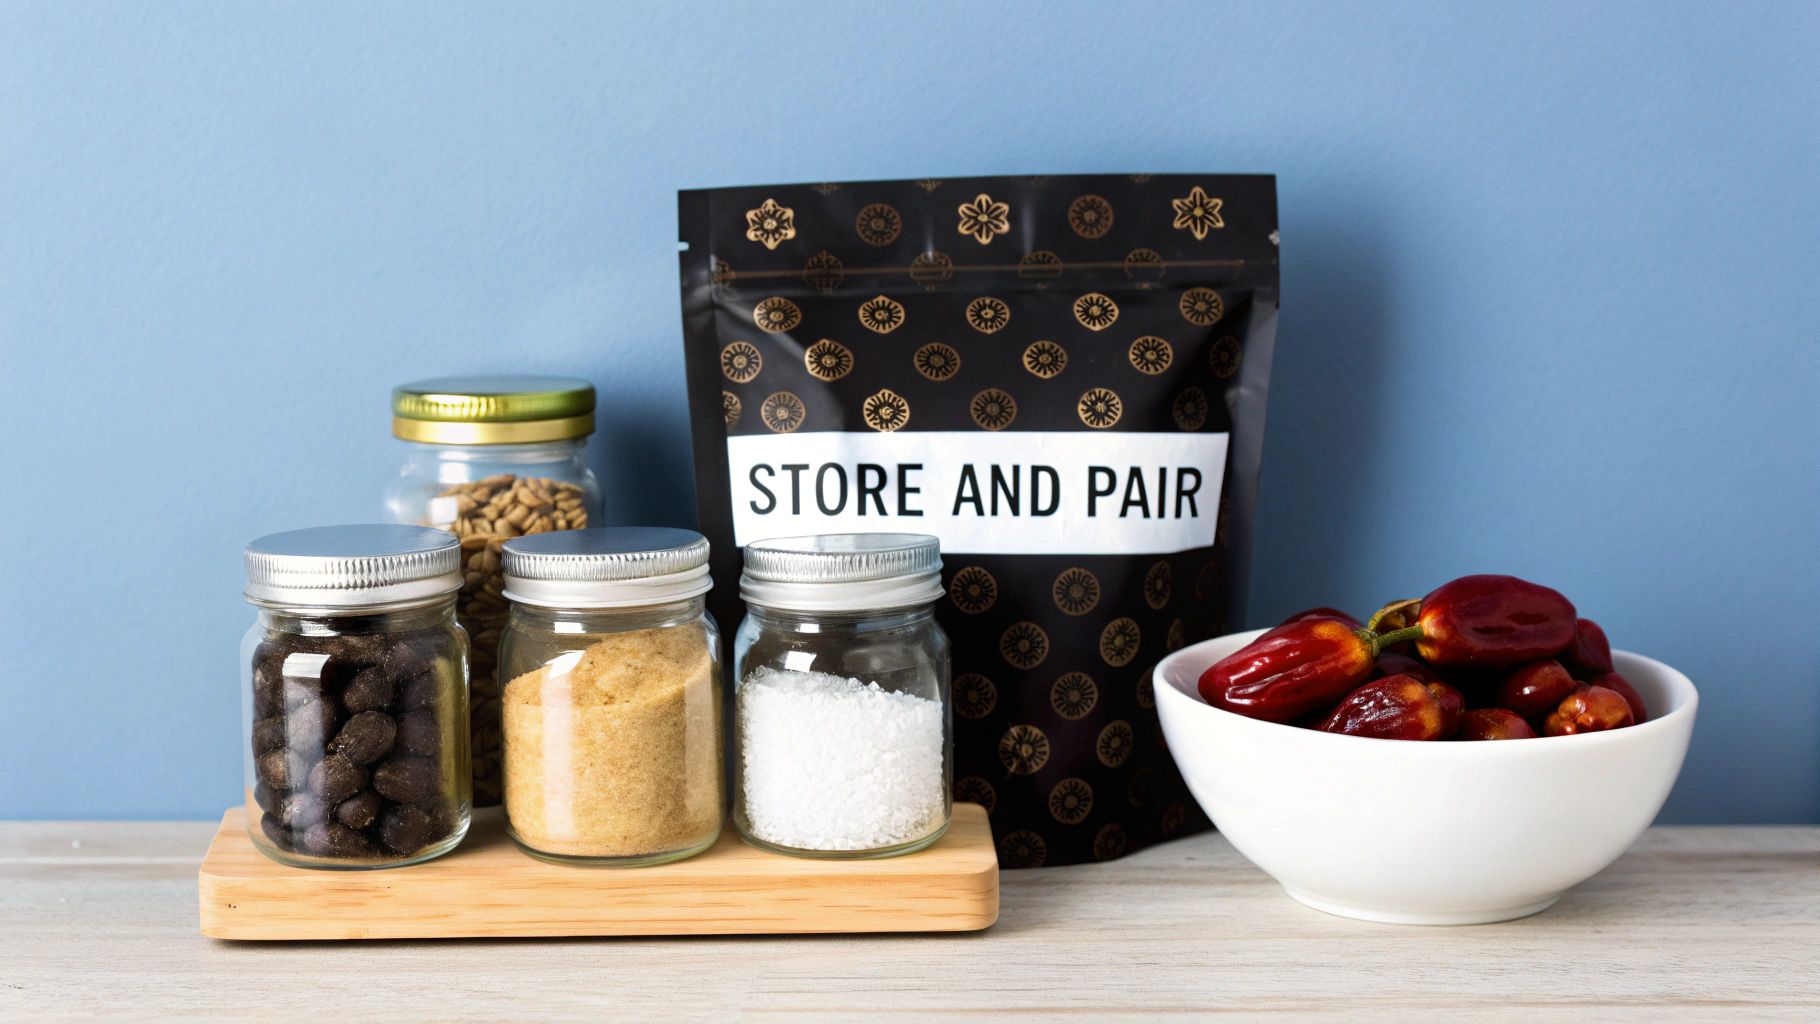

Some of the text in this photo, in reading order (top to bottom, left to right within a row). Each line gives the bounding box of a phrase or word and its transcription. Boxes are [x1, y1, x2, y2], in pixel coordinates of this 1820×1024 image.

[749, 463, 1203, 519] STORE AND PAIR
